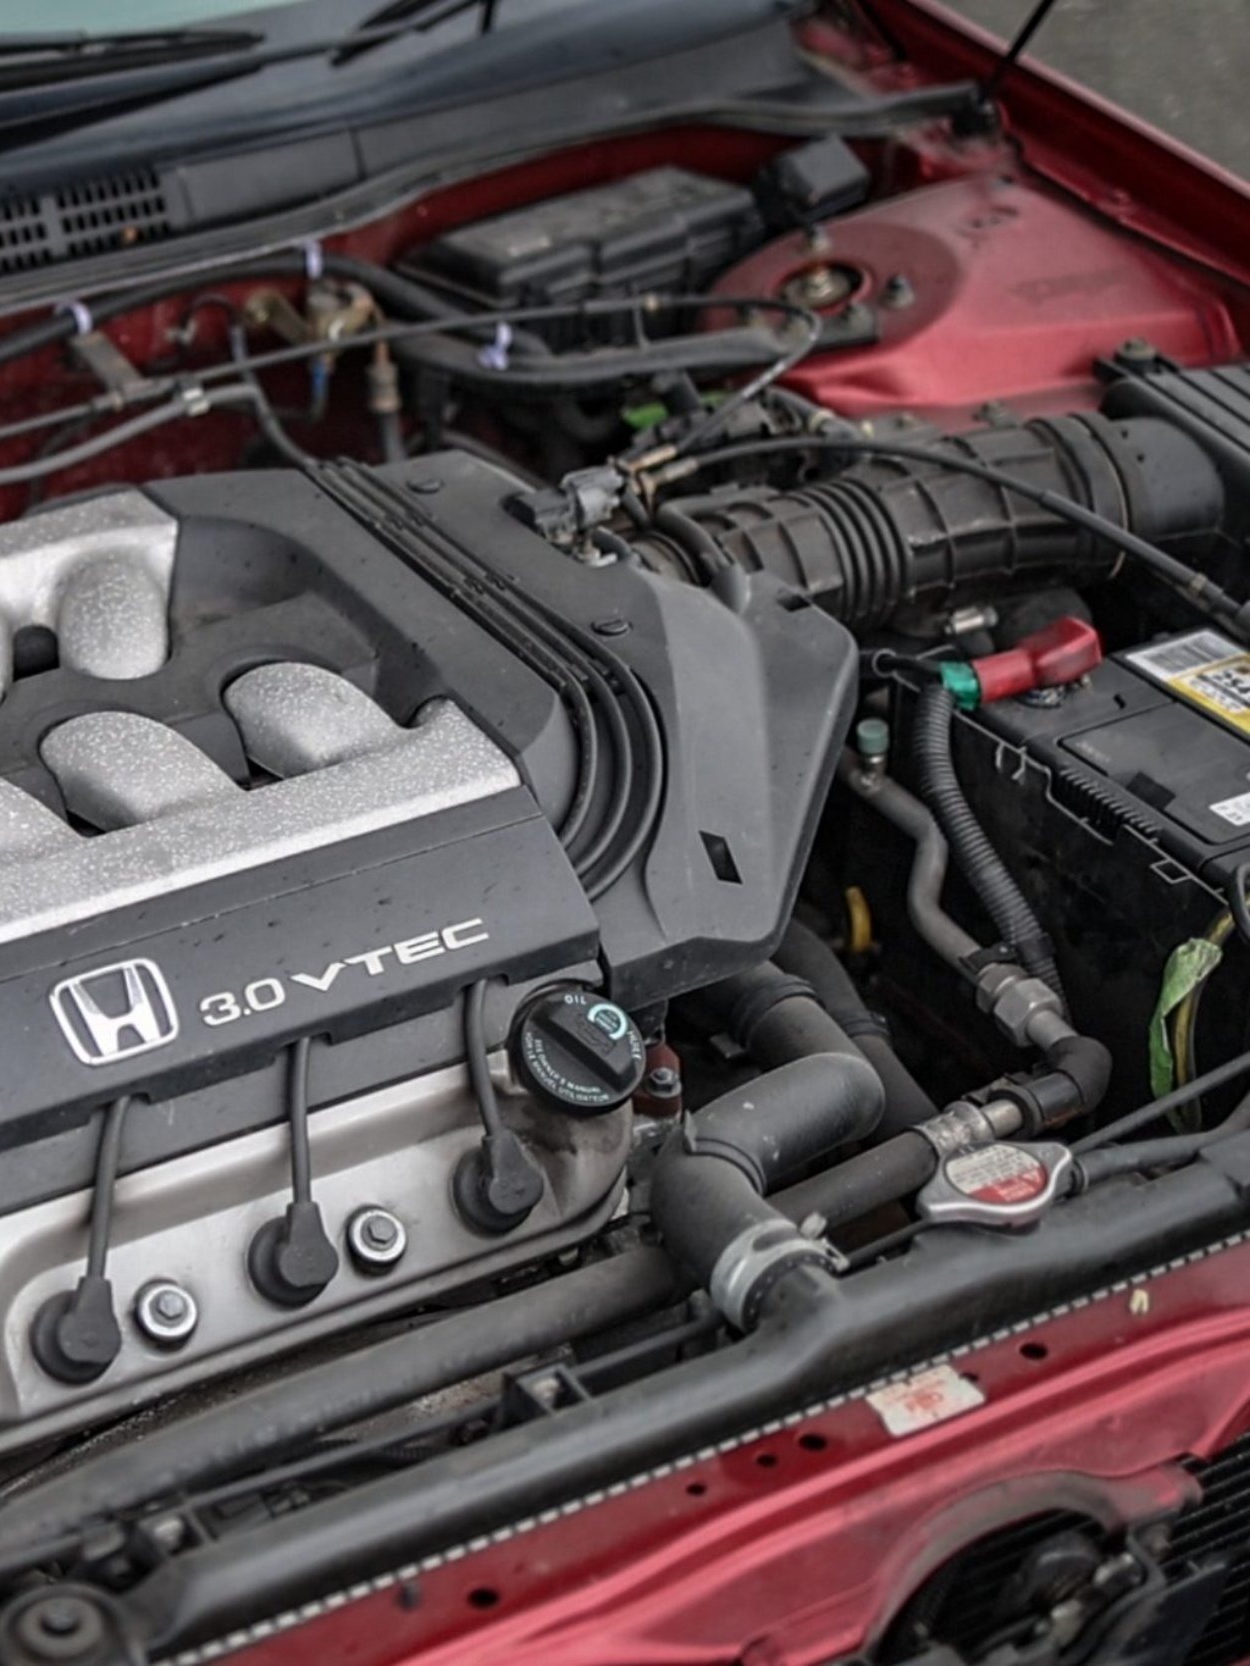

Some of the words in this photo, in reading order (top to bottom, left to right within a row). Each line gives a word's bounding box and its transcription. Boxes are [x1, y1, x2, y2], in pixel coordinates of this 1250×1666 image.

[200, 977, 286, 1026] 3.0
[291, 918, 489, 991] VTEC
[564, 994, 586, 1005] OIL
